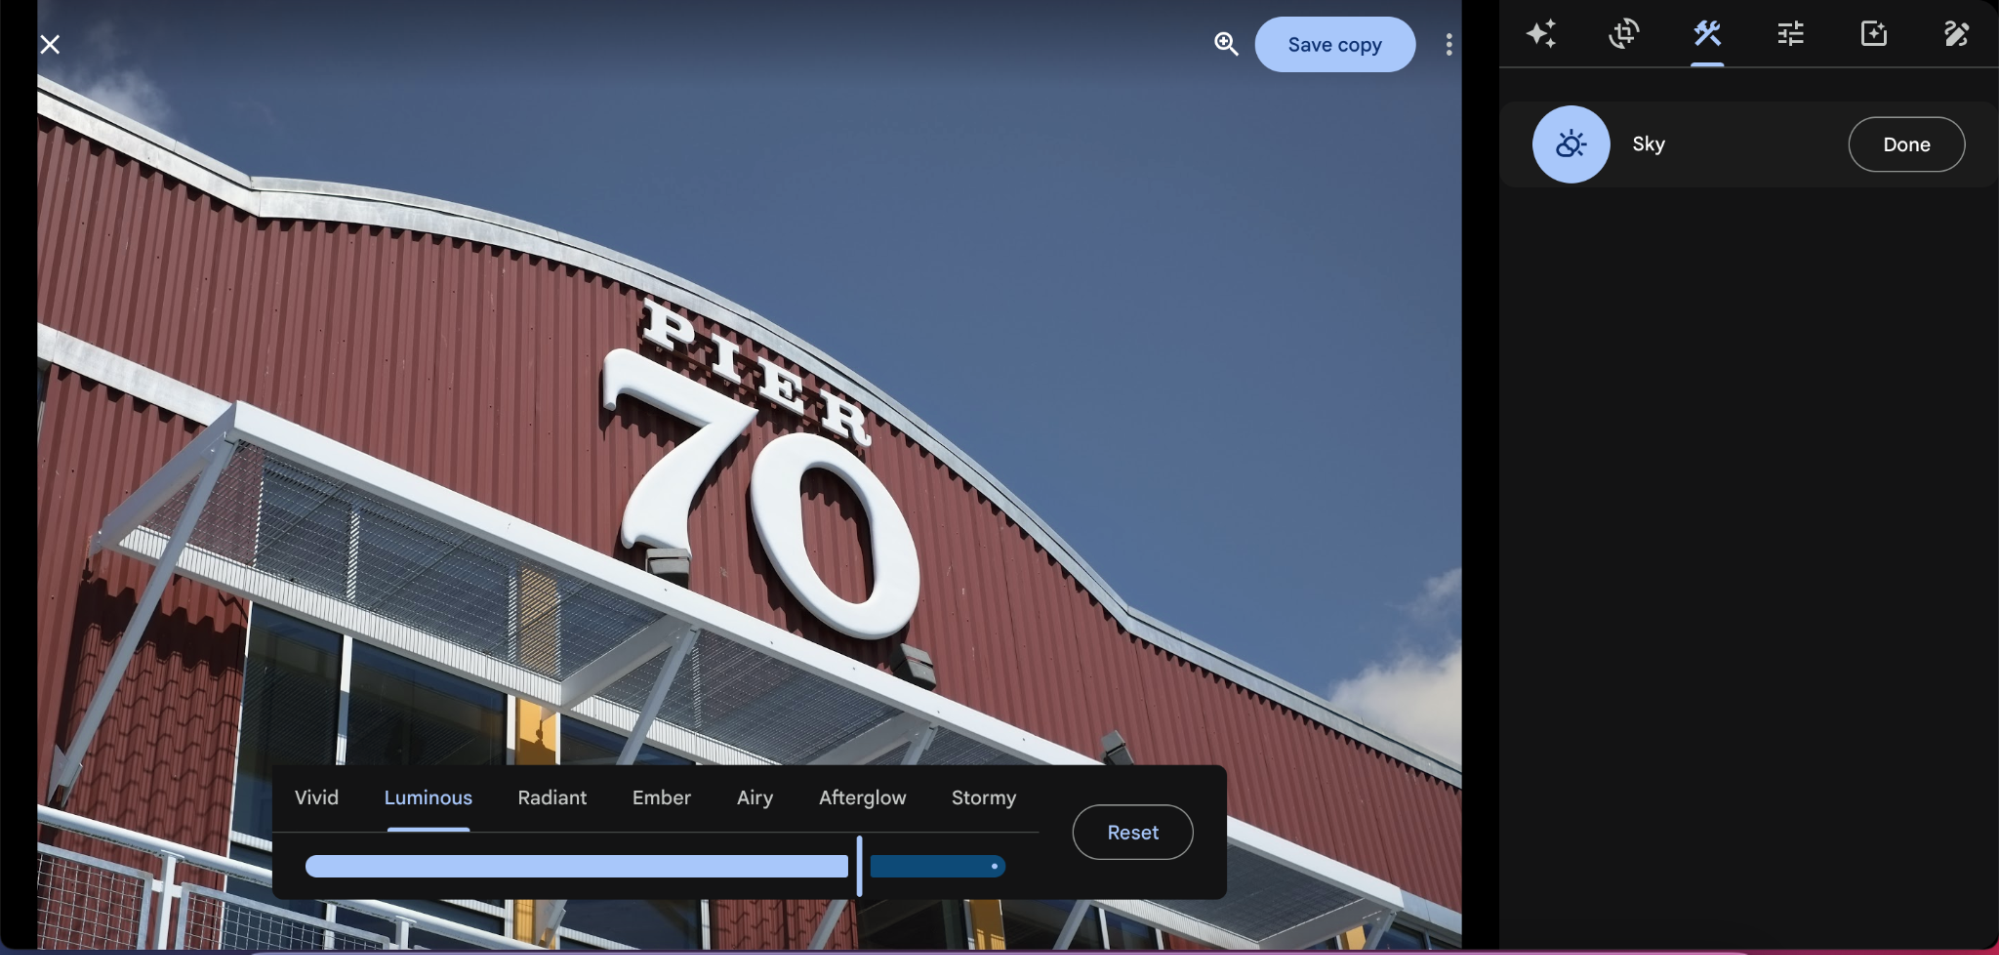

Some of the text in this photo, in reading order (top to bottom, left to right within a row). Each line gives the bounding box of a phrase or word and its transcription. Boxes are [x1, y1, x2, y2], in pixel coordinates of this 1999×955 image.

[1288, 36, 1383, 57] Save copy
[1632, 134, 1666, 156] Sky
[1884, 136, 1932, 153] Done
[643, 298, 871, 446] PIER
[603, 348, 920, 639] 70
[294, 788, 339, 806] Vivid
[384, 788, 473, 806] Luminous
[518, 788, 588, 806] Radiant
[633, 788, 692, 806] Ember
[736, 788, 774, 810] Airy
[818, 788, 907, 810] Afterglow
[951, 789, 1017, 810] Stormy
[1108, 824, 1160, 841] Reset
